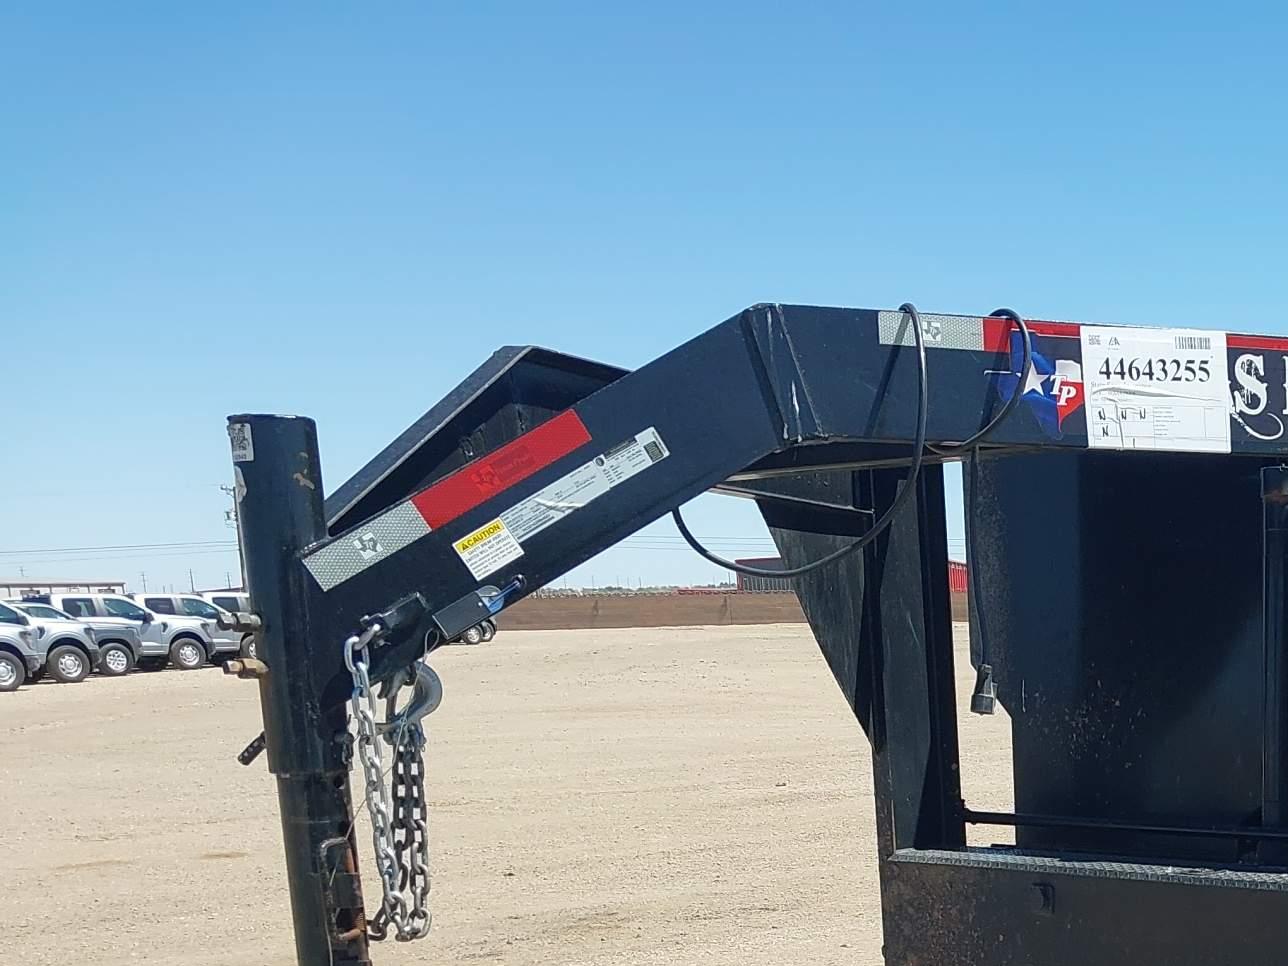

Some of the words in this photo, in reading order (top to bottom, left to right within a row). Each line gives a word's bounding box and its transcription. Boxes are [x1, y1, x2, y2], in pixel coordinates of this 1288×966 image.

[1098, 357, 1211, 383] 44643255
[1050, 375, 1077, 406] TP
[467, 523, 501, 547] CAUTION
